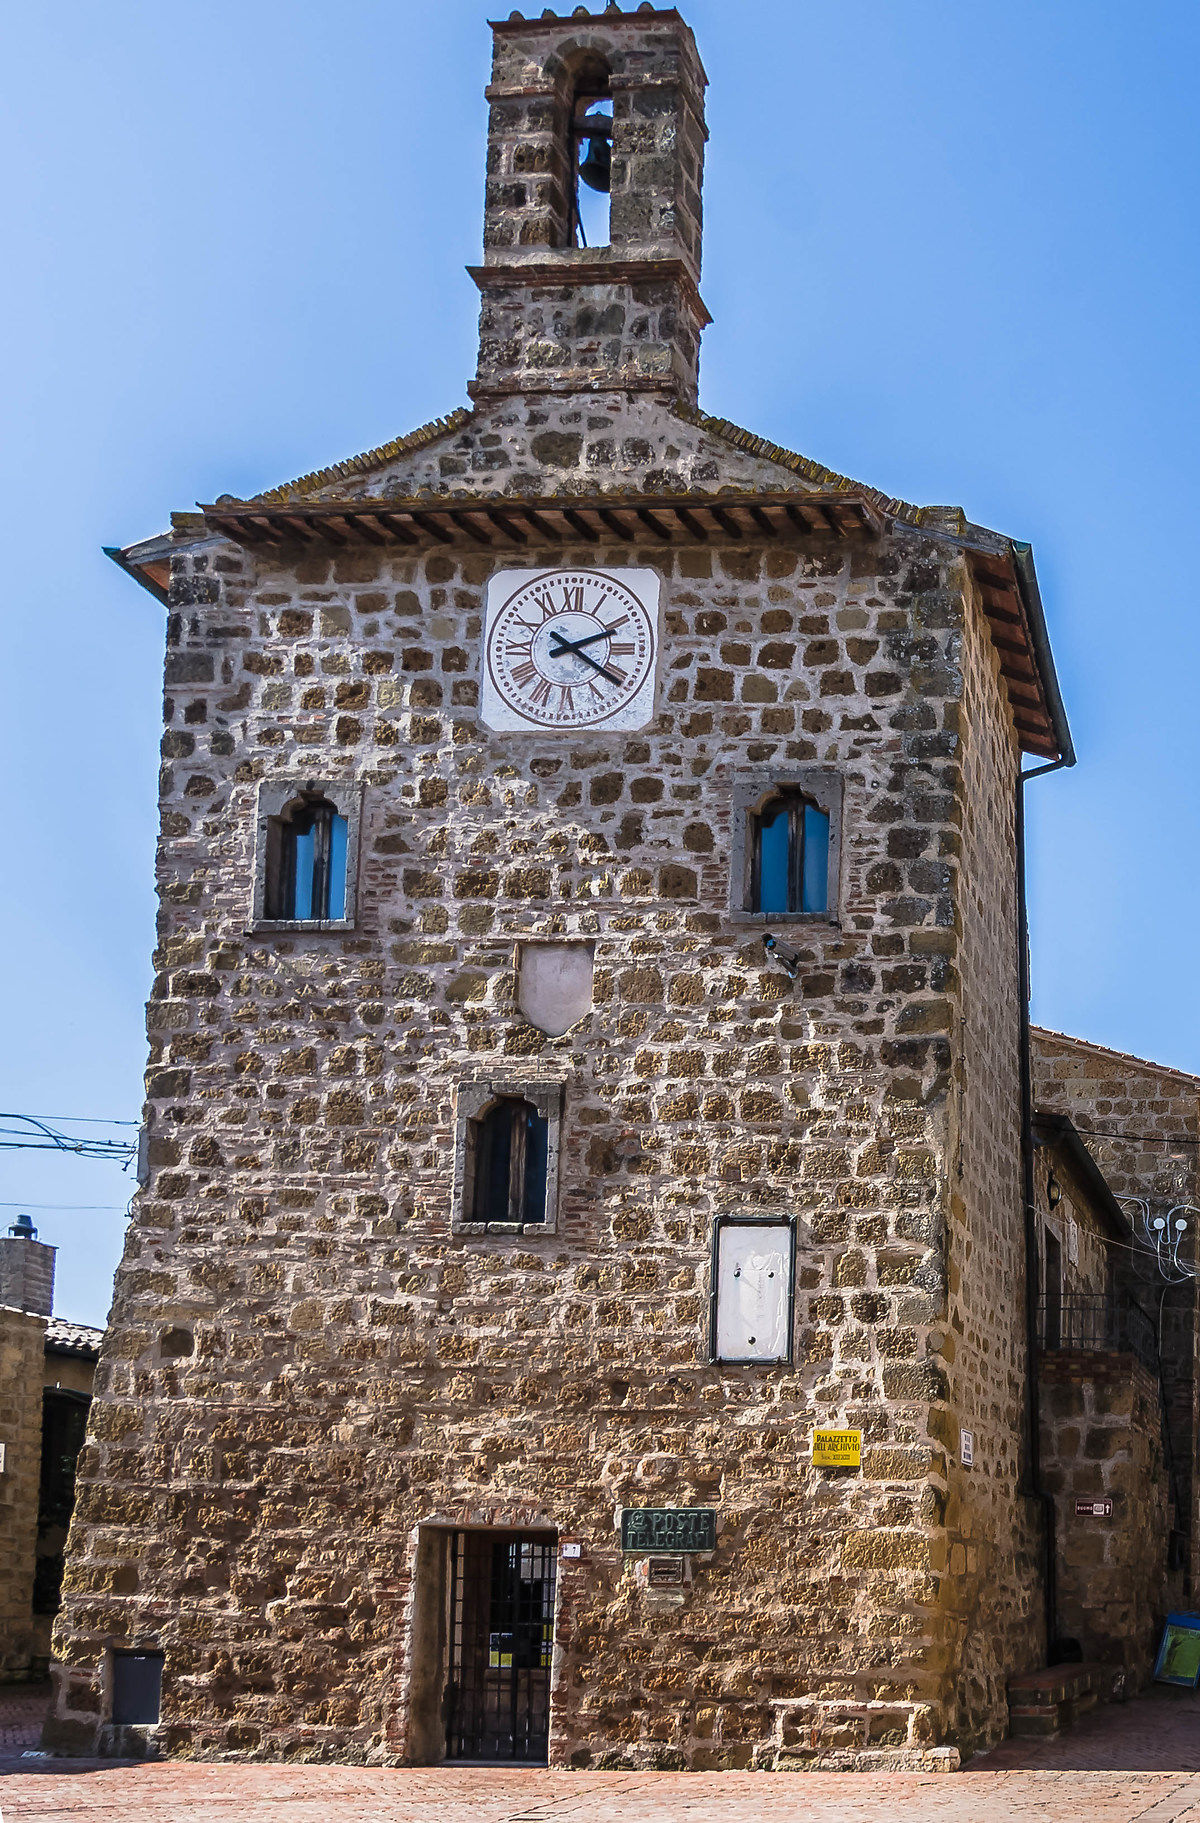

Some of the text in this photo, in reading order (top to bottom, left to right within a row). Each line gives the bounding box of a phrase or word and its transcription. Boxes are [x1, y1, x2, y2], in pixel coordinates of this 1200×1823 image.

[534, 591, 557, 622] XI
[560, 586, 584, 612] XII
[512, 613, 541, 634] X
[505, 638, 531, 656] IX
[610, 642, 636, 656] III
[816, 1434, 858, 1443] PALAZZETTO
[651, 1512, 710, 1531] POSTE
[627, 1531, 710, 1548] TELEGRAFI
